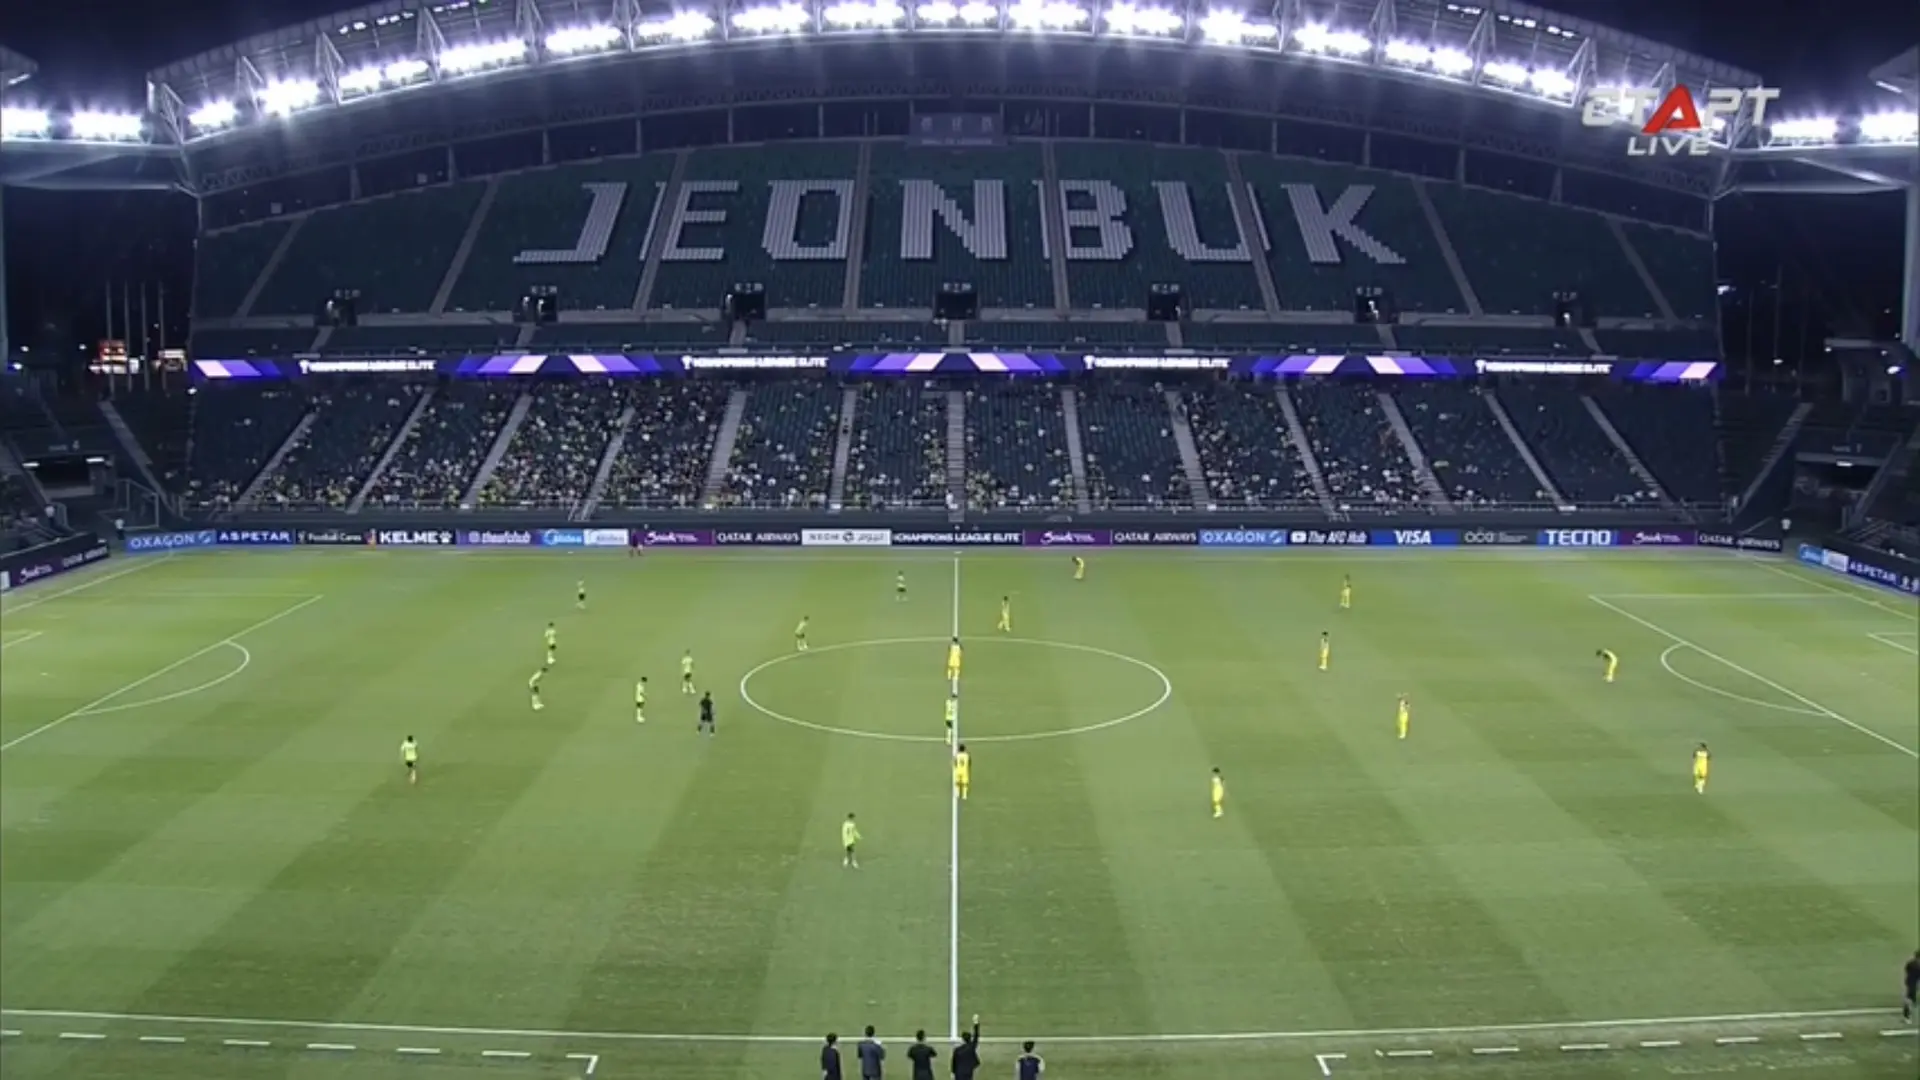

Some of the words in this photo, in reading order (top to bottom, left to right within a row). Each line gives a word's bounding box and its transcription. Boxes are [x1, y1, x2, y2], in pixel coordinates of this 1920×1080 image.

[513, 179, 1407, 264] JEONBUK
[130, 533, 196, 549] OXAGON
[219, 531, 290, 543] ASPETAR
[380, 531, 440, 544] KELME
[717, 532, 752, 543] QATAR
[955, 532, 991, 543] LEAGUE
[993, 532, 1020, 543] ELITE
[1114, 532, 1150, 543] QATAR
[1153, 532, 1197, 543] AIRWAYS
[1202, 531, 1265, 544] OXAGON
[1393, 530, 1432, 545] VISA
[1545, 530, 1611, 545] TECNO
[1699, 533, 1733, 545] QATAR
